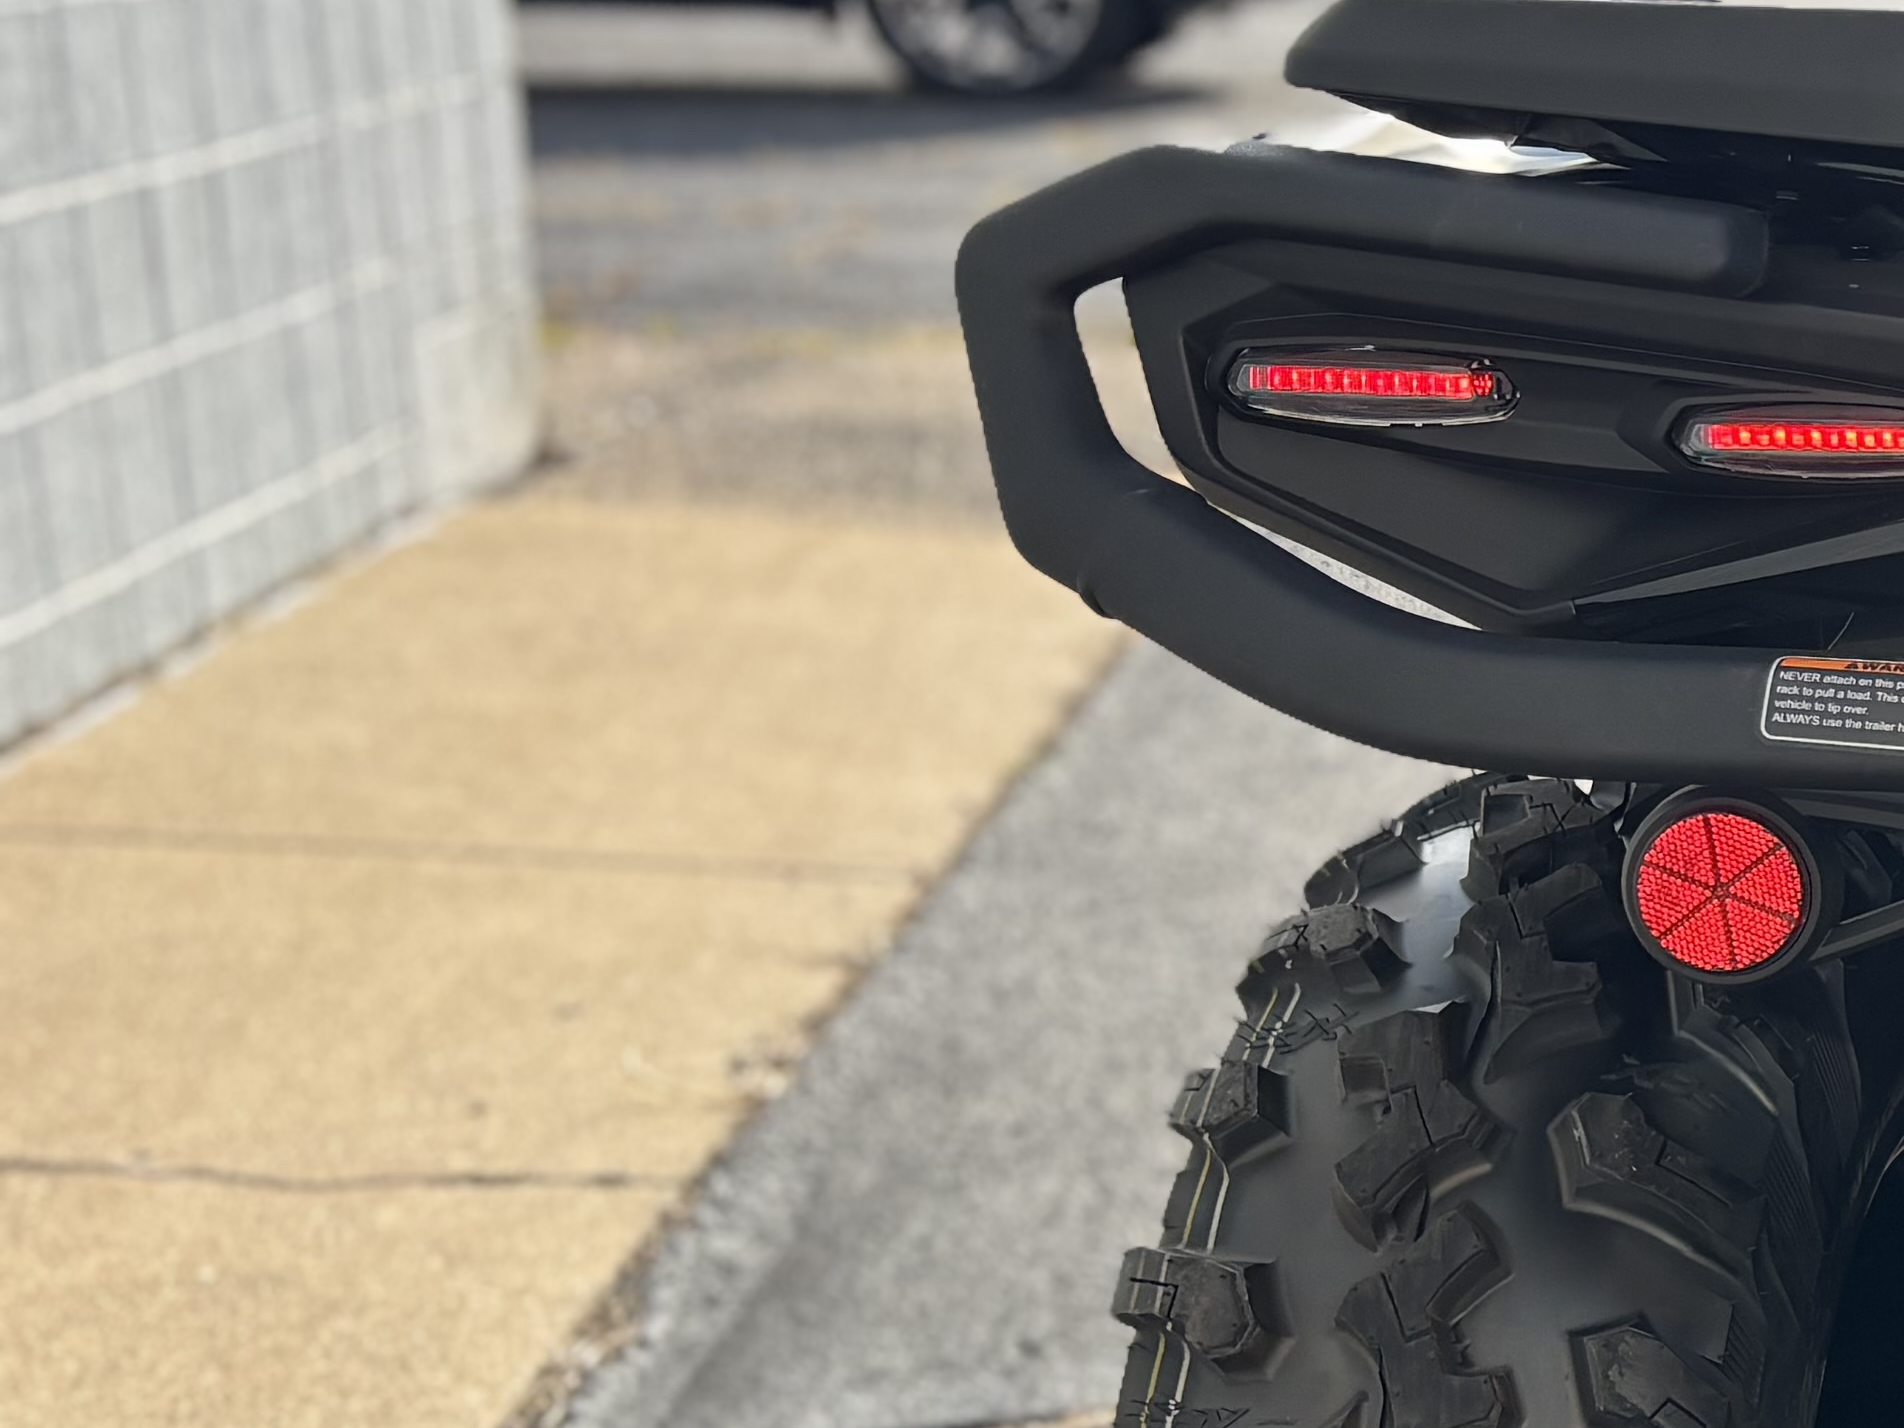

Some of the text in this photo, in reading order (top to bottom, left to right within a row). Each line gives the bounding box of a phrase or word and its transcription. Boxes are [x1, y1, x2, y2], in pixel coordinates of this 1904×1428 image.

[1779, 671, 1821, 683] NEVER
[1823, 675, 1856, 685] attach
[1858, 677, 1872, 687] on
[1875, 678, 1894, 688] this
[1776, 685, 1800, 695] rack
[1802, 687, 1814, 696] to
[1815, 688, 1836, 699] pull
[1836, 690, 1845, 699] a
[1846, 690, 1873, 701] load.
[1876, 691, 1899, 703] This
[1774, 699, 1869, 715] vehicle to tip over.
[1771, 713, 1820, 726] ALWAYS
[1822, 718, 1842, 727] use
[1845, 719, 1862, 729] the
[1864, 721, 1896, 732] trailer
